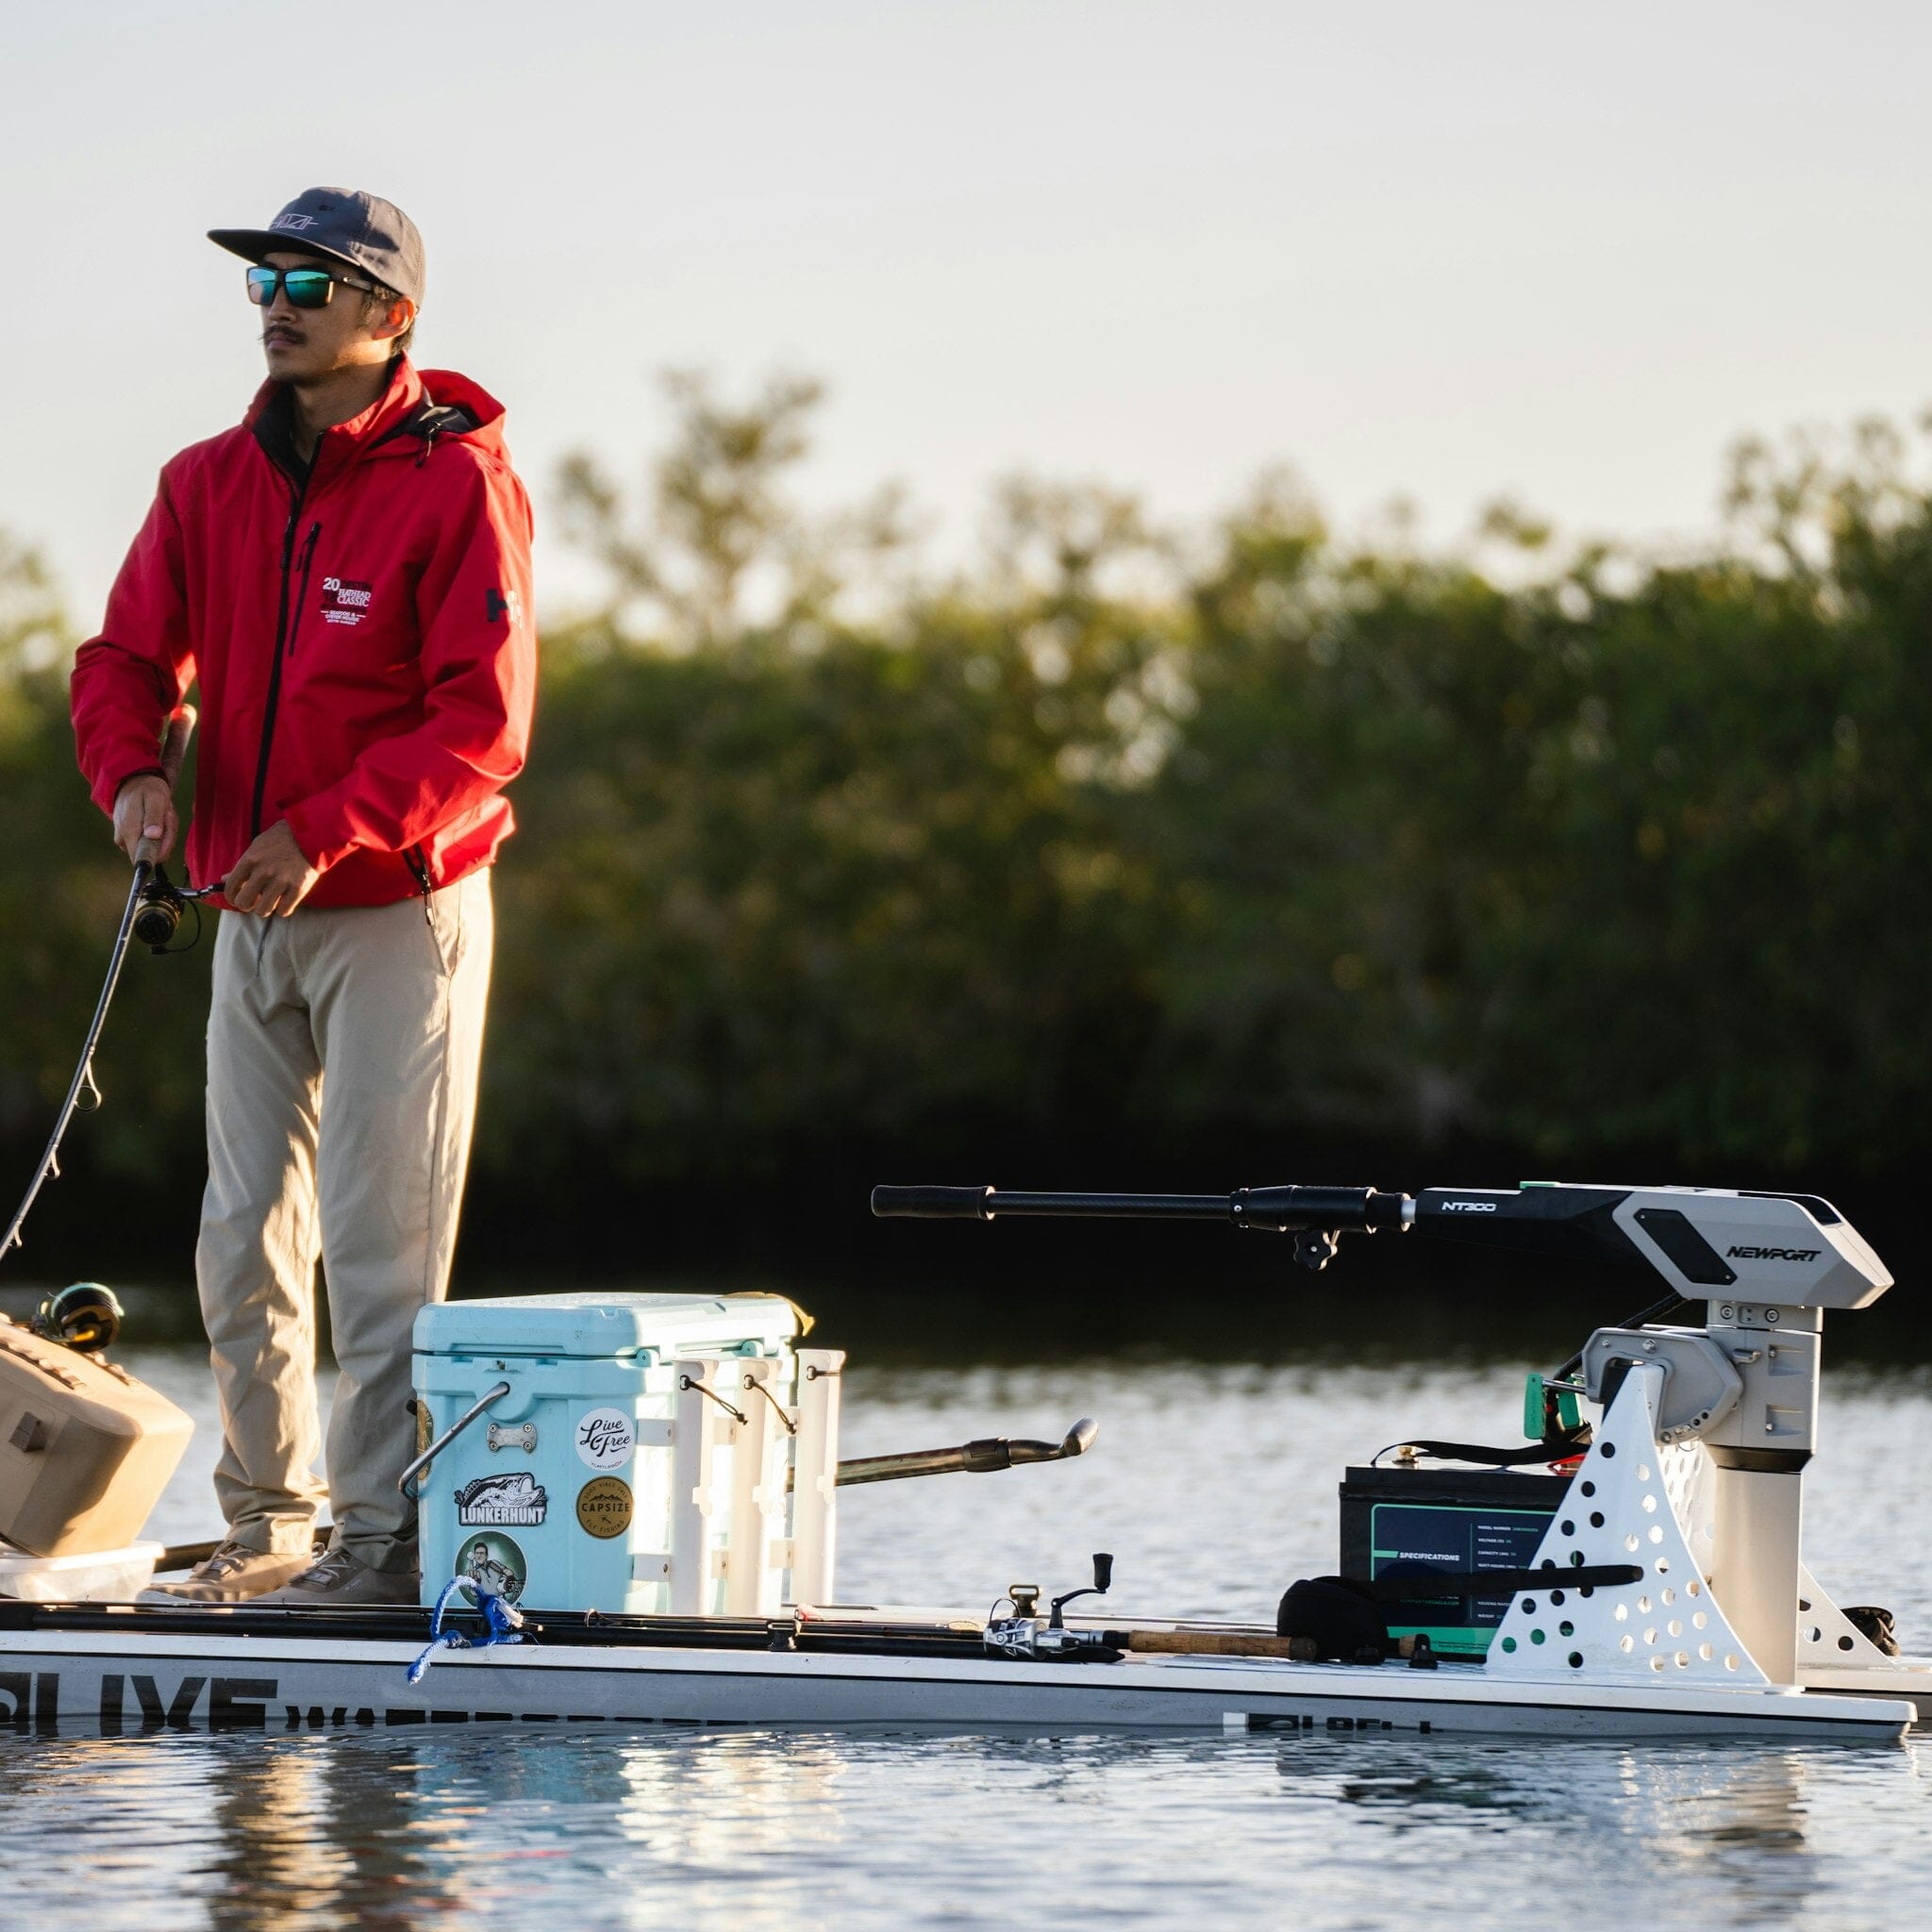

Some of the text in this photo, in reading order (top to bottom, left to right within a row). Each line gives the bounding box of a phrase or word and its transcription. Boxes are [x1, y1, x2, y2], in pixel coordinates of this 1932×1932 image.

[323, 576, 341, 591] 20
[338, 588, 372, 599] FLATHEAD
[337, 595, 370, 608] CLASSIC
[1441, 1202, 1497, 1212] NT300
[1725, 1245, 1823, 1262] NEWPORT
[579, 1419, 625, 1445] Live
[590, 1428, 631, 1457] Free
[581, 1503, 630, 1512] CAPSIZE
[460, 1506, 545, 1524] LUNKERHUNT
[1399, 1552, 1460, 1561] SPECIFICATIONS
